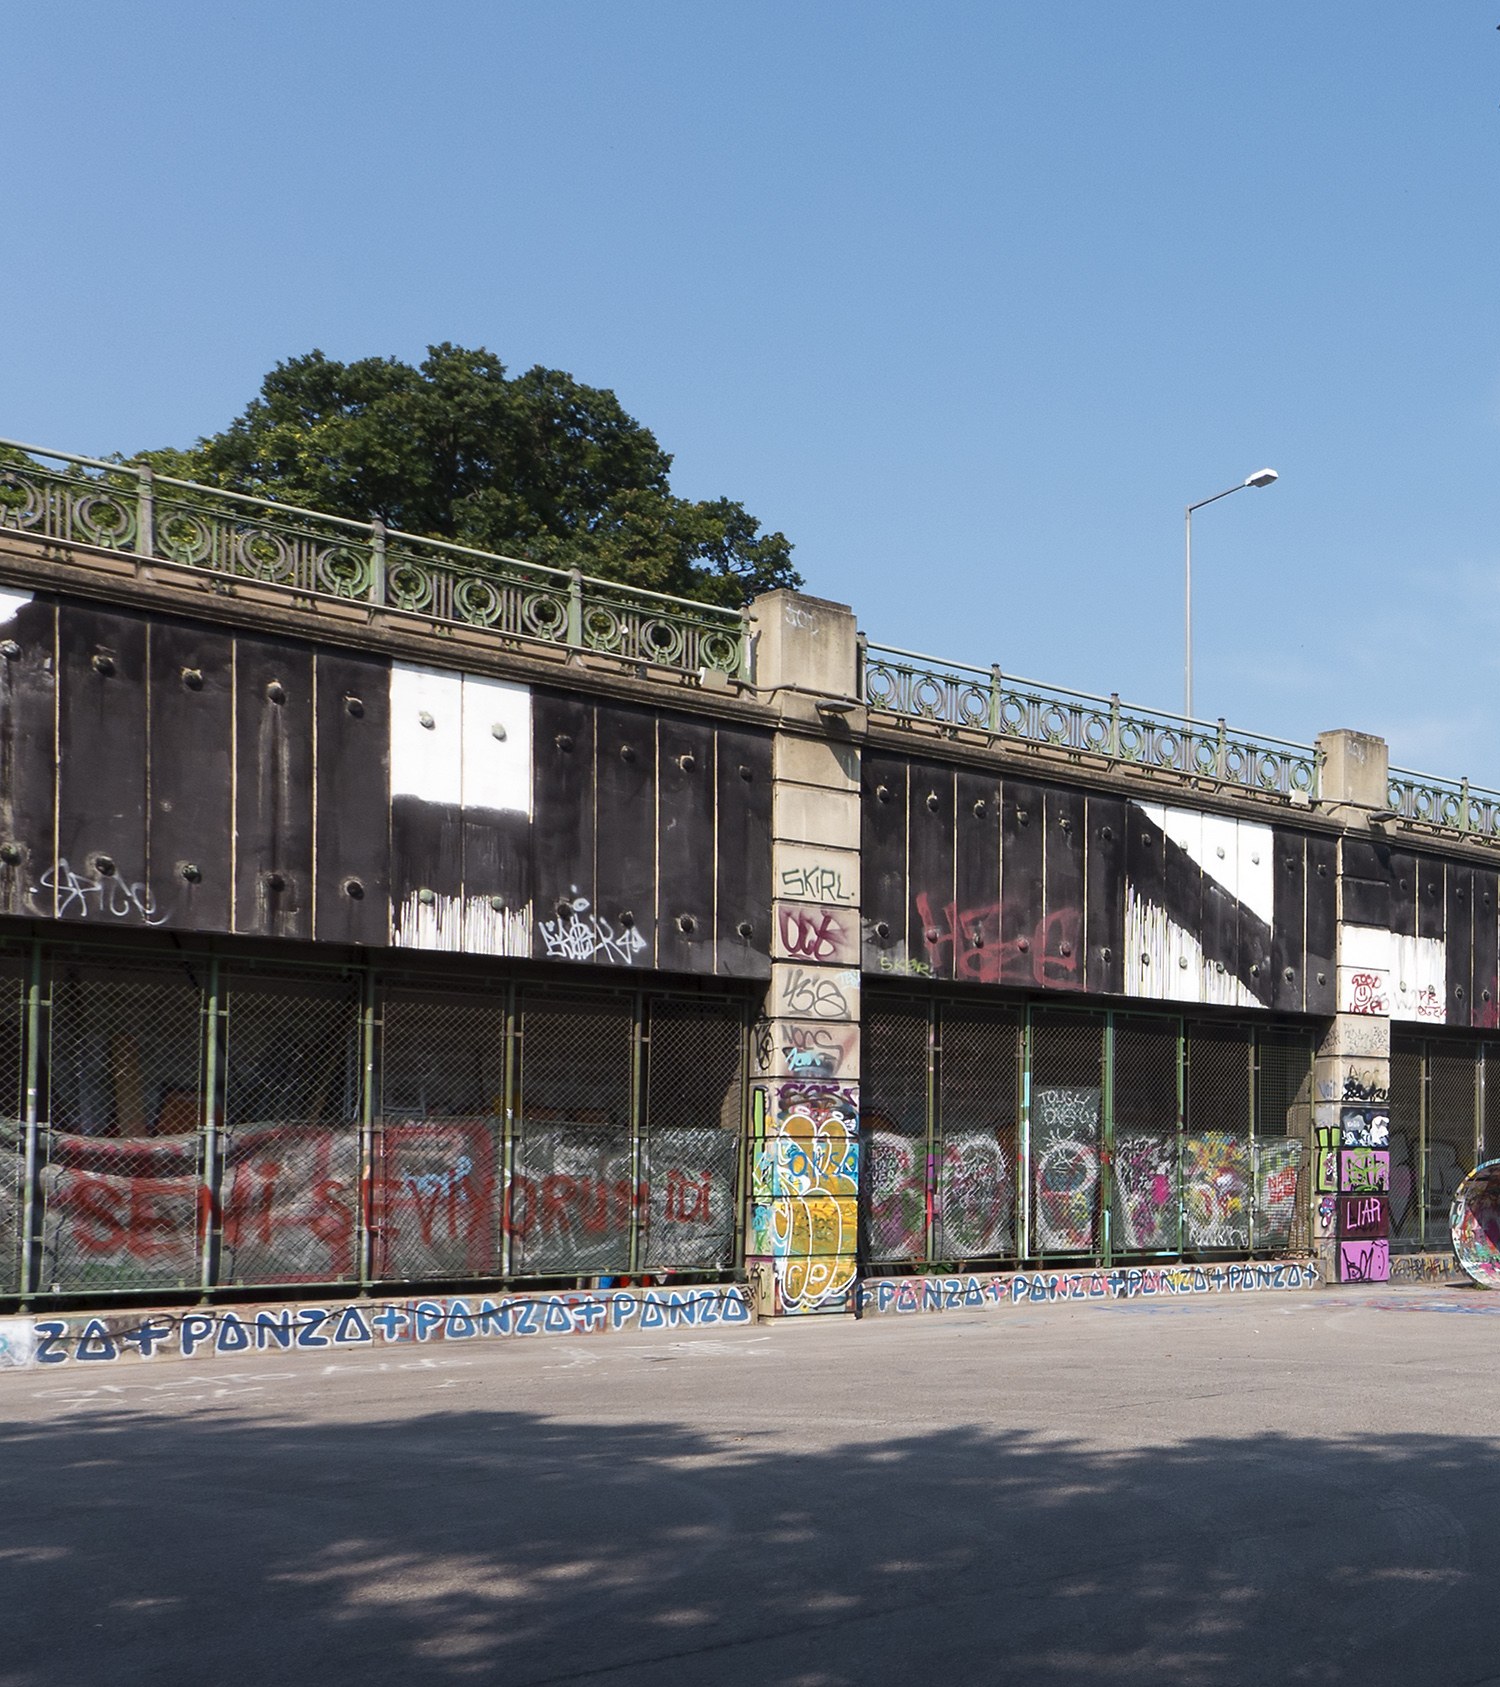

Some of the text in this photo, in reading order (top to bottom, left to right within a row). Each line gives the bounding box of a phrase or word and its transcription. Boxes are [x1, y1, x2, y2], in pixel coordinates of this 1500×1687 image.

[1346, 1198, 1382, 1230] LIAR
[180, 1306, 374, 1358] PANZA
[414, 1295, 575, 1342] PANZA
[611, 1284, 752, 1331] PANZA
